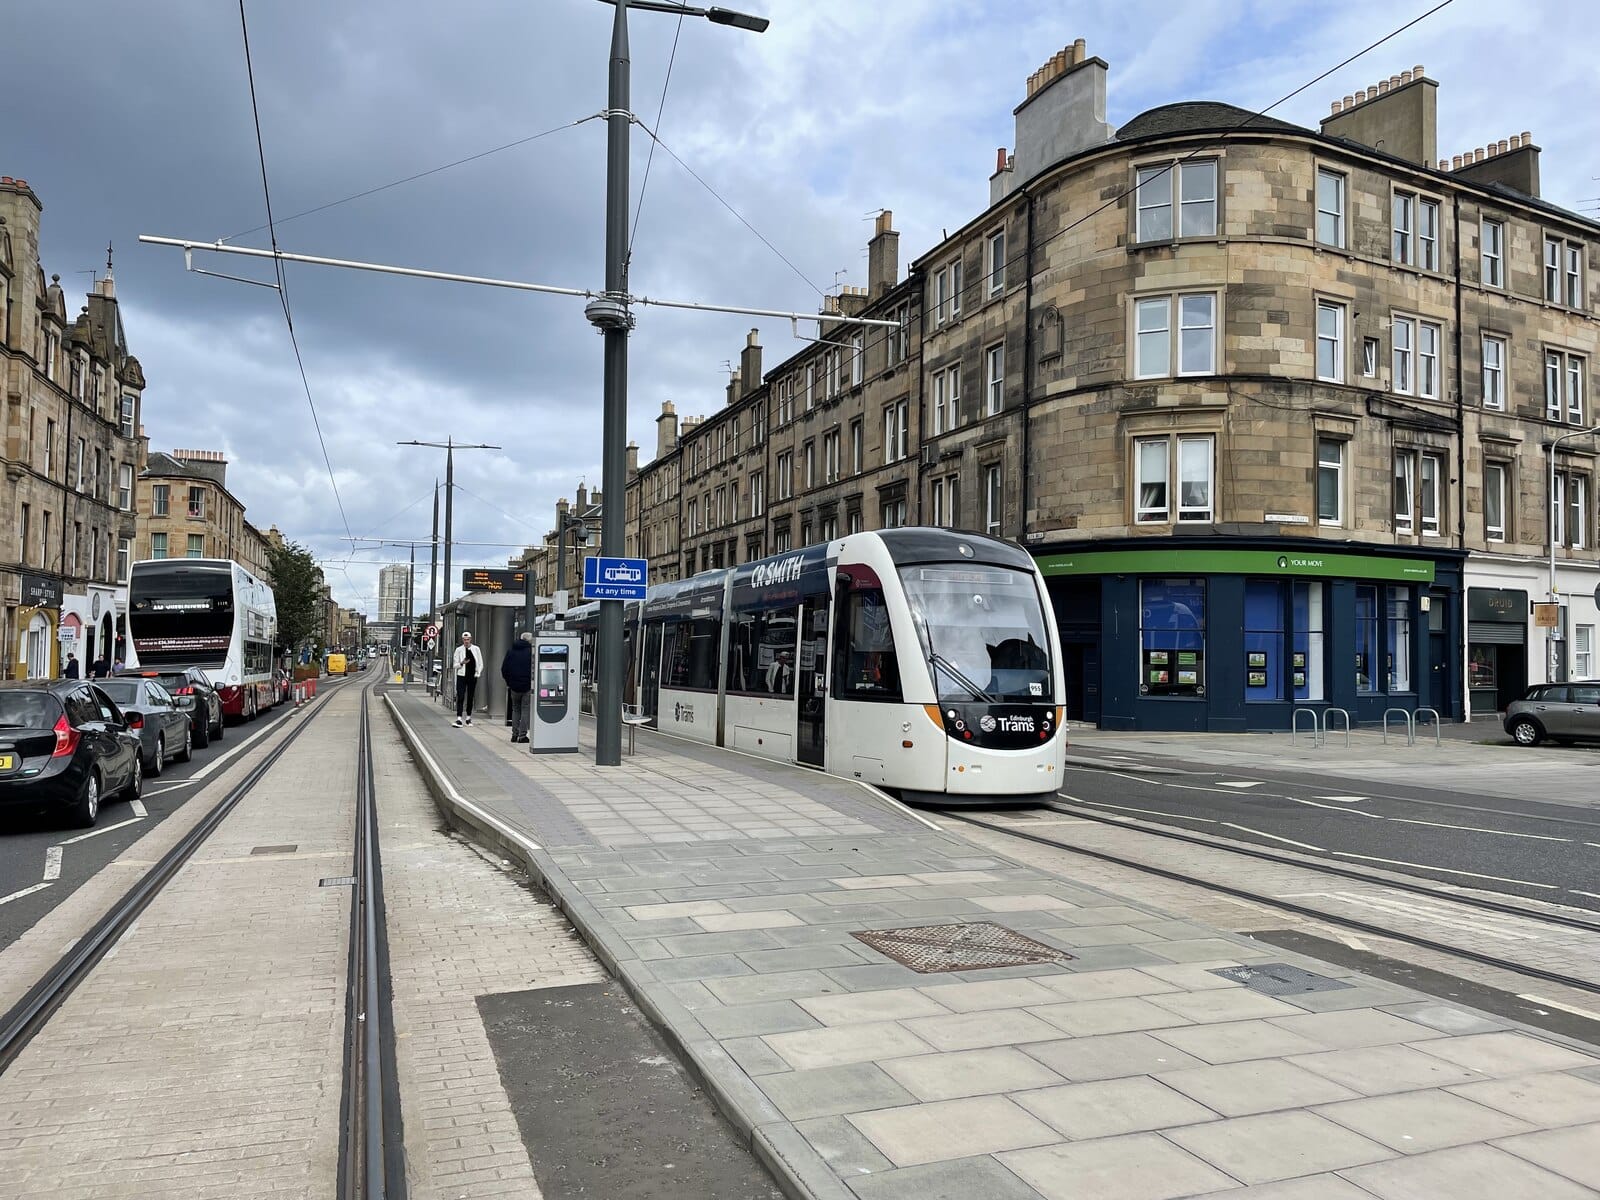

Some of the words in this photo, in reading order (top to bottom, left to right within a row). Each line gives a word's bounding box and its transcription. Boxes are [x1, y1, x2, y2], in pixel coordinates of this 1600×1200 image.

[751, 564, 766, 588] CR
[765, 554, 804, 586] SMITH
[30, 587, 43, 597] SHARP
[44, 589, 55, 599] STYLE
[1488, 598, 1513, 608] DRUID
[680, 705, 694, 723] Trams
[998, 718, 1034, 732] Trams
